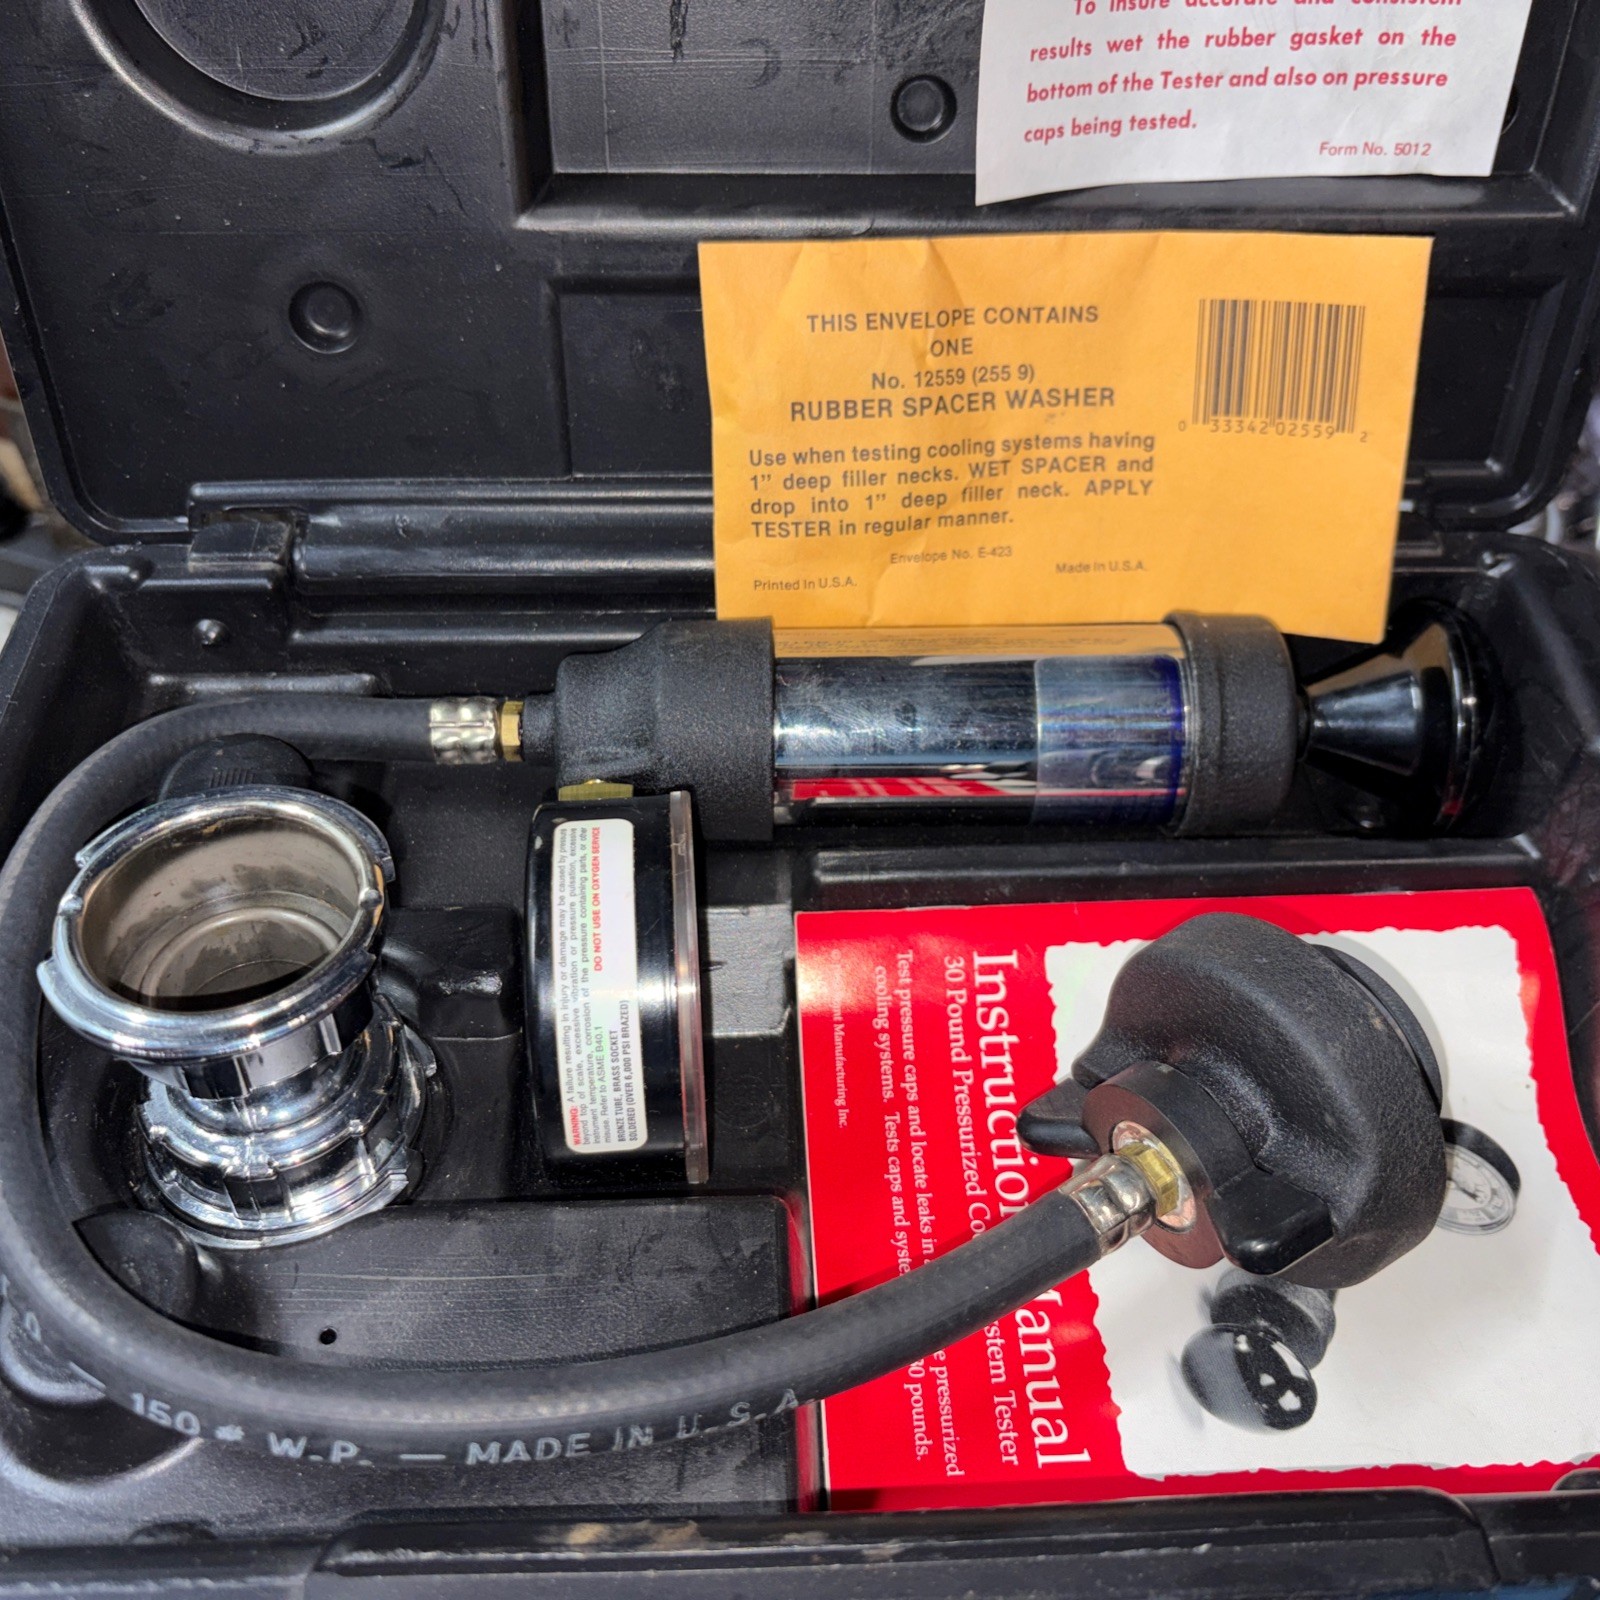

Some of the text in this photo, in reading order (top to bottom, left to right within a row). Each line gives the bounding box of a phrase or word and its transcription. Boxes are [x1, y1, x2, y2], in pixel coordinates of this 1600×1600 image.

[1074, 0, 1096, 15] To
[1030, 25, 1456, 62] results wet the rubber gasket on the
[1026, 66, 1448, 102] bottom of the Tester and also on pressure
[1023, 109, 1197, 145] caps being tested.
[1319, 141, 1432, 157] Form No. 5012
[806, 305, 1099, 332] THIS ENVELOPE CONTAINS
[930, 337, 973, 357] ONE
[871, 364, 1035, 390] No. 12559 (255 9)
[791, 387, 1115, 422] RUBBER SPACER WASHER
[749, 431, 1155, 466] Use when testing cooling systems having
[1178, 419, 1368, 443] 0 33342 02559 2
[783, 473, 831, 492] deep
[842, 470, 887, 487] filler
[897, 466, 958, 484] necks.
[969, 460, 1011, 479] WET
[1021, 456, 1106, 474] SPACER
[1117, 456, 1154, 472] and
[751, 498, 795, 518] drop
[811, 497, 849, 513] into
[901, 492, 947, 509] deep
[961, 486, 1003, 503] filler
[1017, 481, 1069, 499] neck.
[1084, 479, 1153, 496] APPLY
[751, 510, 1014, 538] TESTER in regular manner.
[890, 545, 1013, 565] Envelope No. E-423
[1055, 561, 1091, 574] Made
[754, 578, 800, 591] Printed
[818, 576, 857, 589] U.S.A.
[592, 827, 600, 854] SERVICE
[569, 860, 577, 896] pulsation,
[592, 856, 600, 890] OXYGEN
[558, 896, 565, 905] be
[579, 877, 588, 918] containing
[593, 893, 600, 906] ON
[569, 902, 578, 939] pressure
[559, 931, 567, 967] damage
[570, 946, 577, 955] or
[580, 923, 589, 962] pressure
[593, 933, 601, 952] NOT
[561, 971, 567, 980] or
[594, 956, 602, 971] DO
[944, 956, 965, 982] 30
[561, 985, 570, 1009] injury
[570, 961, 578, 1002] vibration
[572, 1008, 582, 1054] excessive
[583, 1002, 592, 1045] corrosion
[946, 990, 970, 1062] Pound
[563, 1026, 572, 1063] resulting
[565, 1068, 574, 1093] failure
[576, 1060, 584, 1085] scale,
[587, 1051, 596, 1104] temperature,
[597, 1056, 605, 1082] ASME
[619, 1000, 637, 1141] SOLDERED (OVER 6,000 PSI BRAZED)
[832, 1024, 848, 1106] Manufacturing
[610, 1030, 626, 1141] BRONZE TUBE, BRASS SOCKET
[896, 951, 937, 1254] Test pressure caps and locate leaks in
[579, 1104, 588, 1116] top
[600, 1095, 608, 1115] Refer
[837, 1109, 850, 1128] Inc.
[872, 966, 912, 1276] cooling systems. Tests caps and syste
[570, 1106, 581, 1145] WARNING:
[581, 1120, 590, 1144] beyond
[603, 1118, 611, 1142] misuse.
[952, 1070, 987, 1196] Pressurized
[984, 1322, 1019, 1466] stem Tester
[131, 1392, 200, 1436] 150
[268, 1432, 373, 1466] W.P.
[465, 1433, 591, 1465] MADE
[613, 1425, 654, 1450] IN
[903, 1383, 932, 1460] pounds.
[932, 1367, 964, 1476] pressurized
